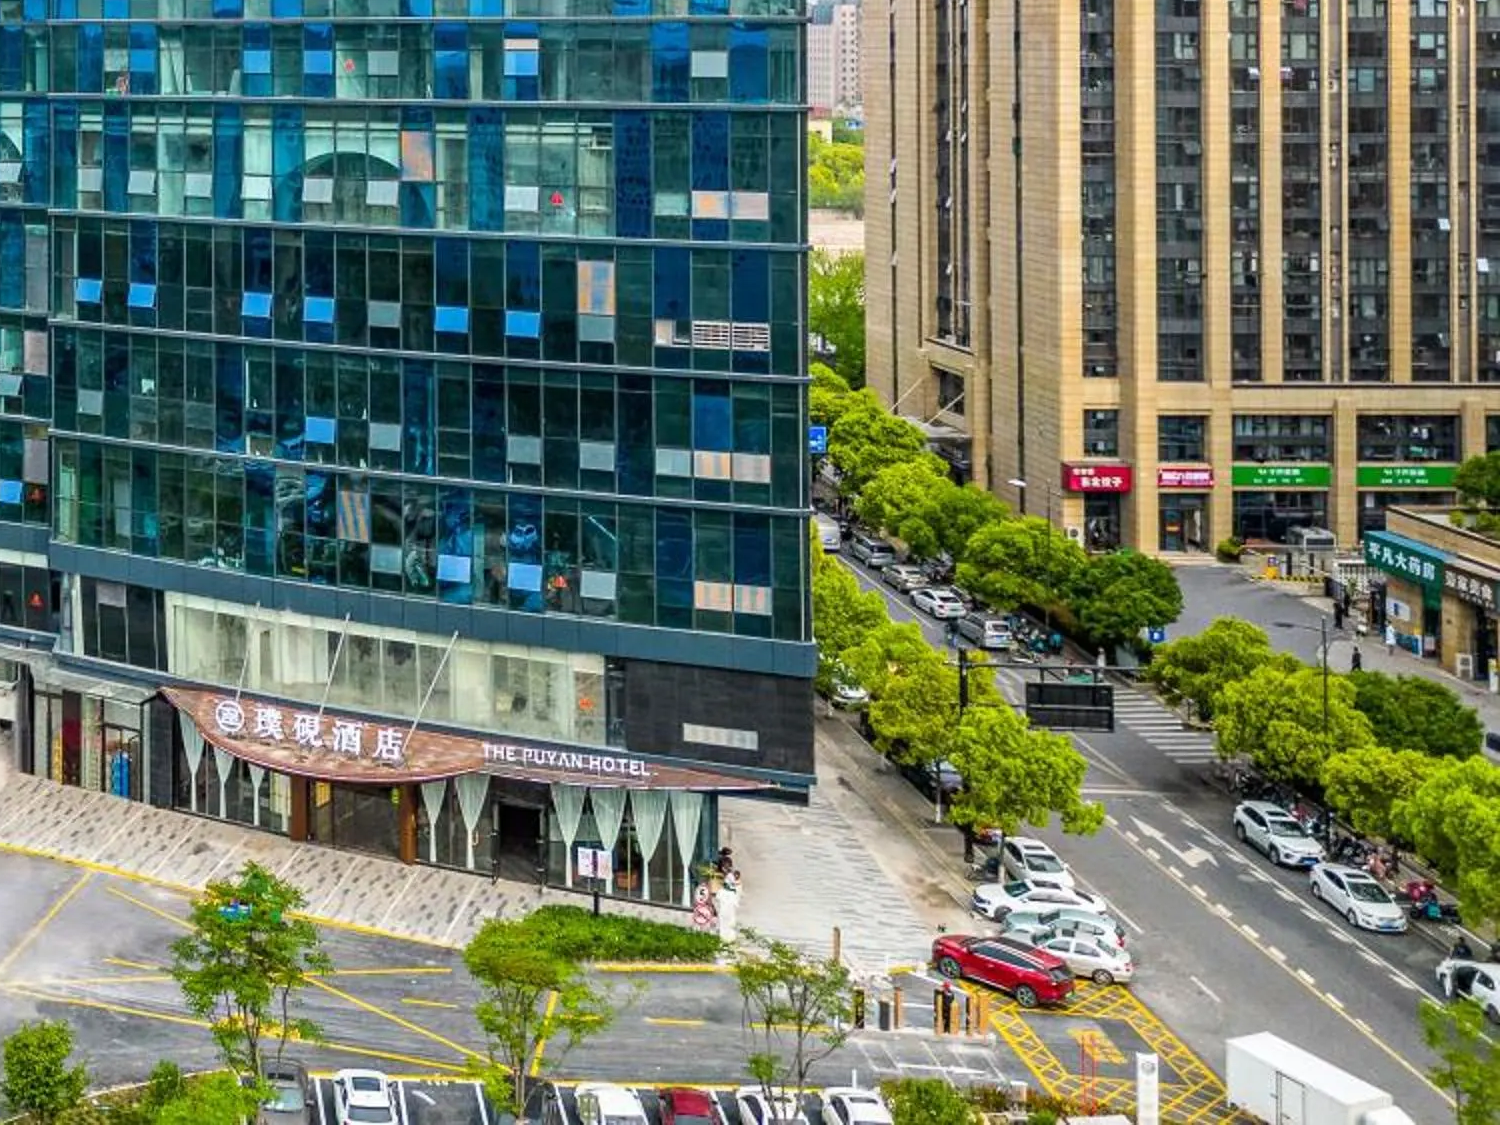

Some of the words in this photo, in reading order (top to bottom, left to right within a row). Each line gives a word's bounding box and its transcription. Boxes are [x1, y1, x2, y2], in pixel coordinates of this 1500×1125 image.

[483, 742, 516, 762] THE
[524, 748, 583, 770] PUYAN
[589, 755, 650, 776] HOTEL
